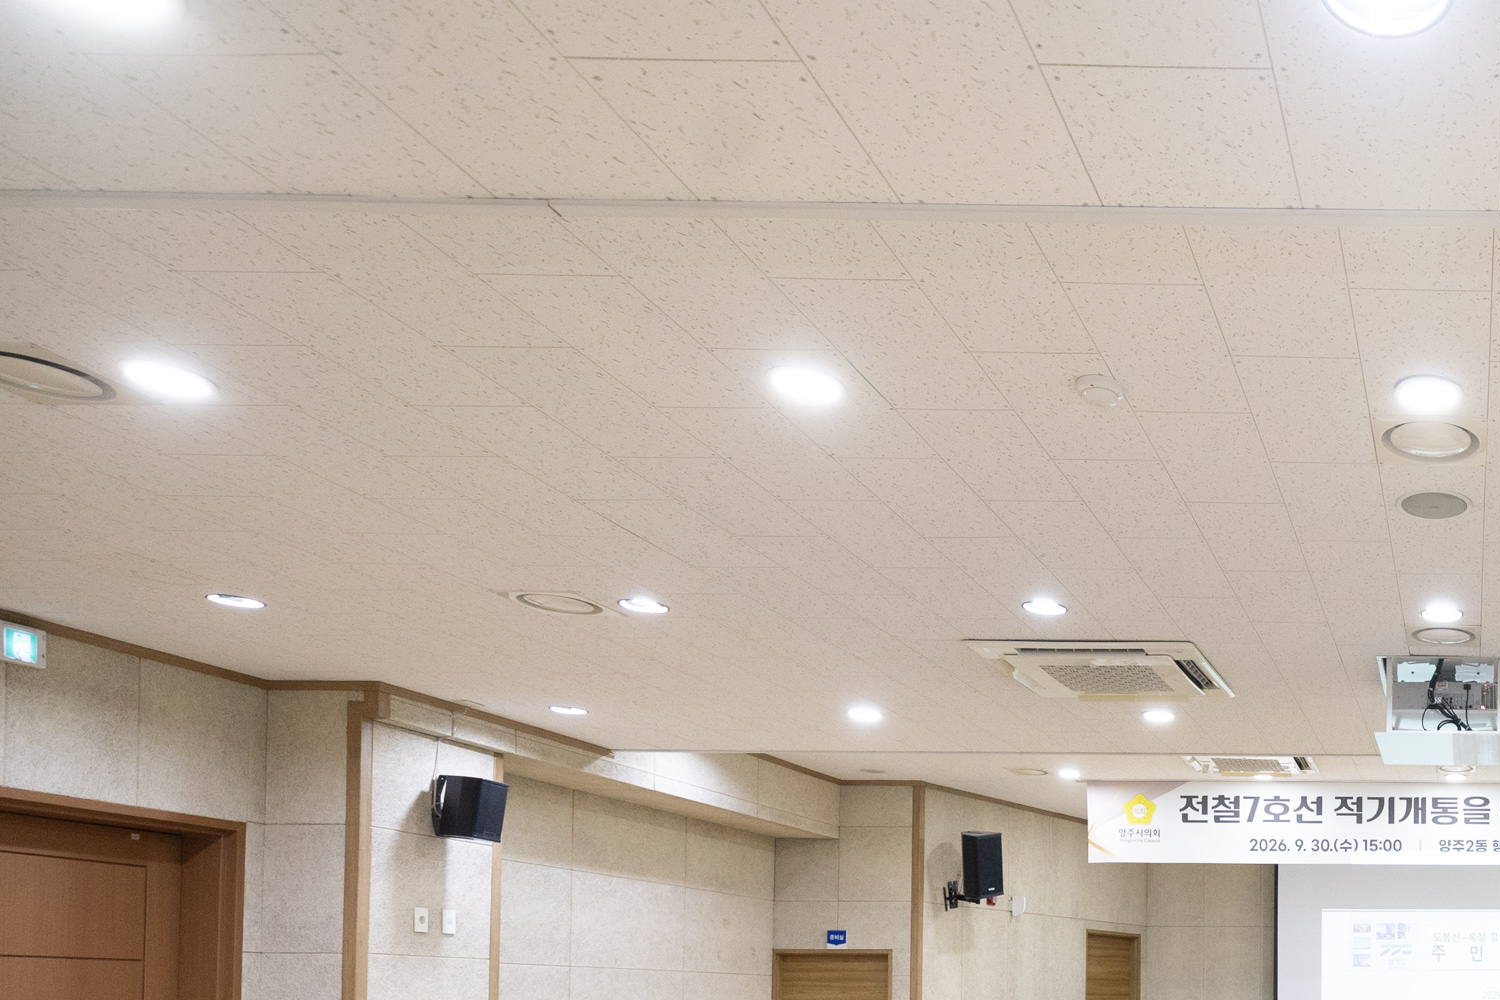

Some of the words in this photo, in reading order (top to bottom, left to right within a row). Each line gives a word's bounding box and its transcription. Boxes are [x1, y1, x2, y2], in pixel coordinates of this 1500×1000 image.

[1179, 794, 1323, 824] 전철7호선
[1333, 796, 1491, 826] 적기개통을
[1118, 828, 1161, 838] 양주시의회
[1249, 838, 1290, 852] 2026.
[1294, 838, 1306, 852] 9.
[1311, 838, 1359, 853] 30.(수)
[1362, 839, 1402, 852] 15:00
[1438, 839, 1488, 853] 양주2동
